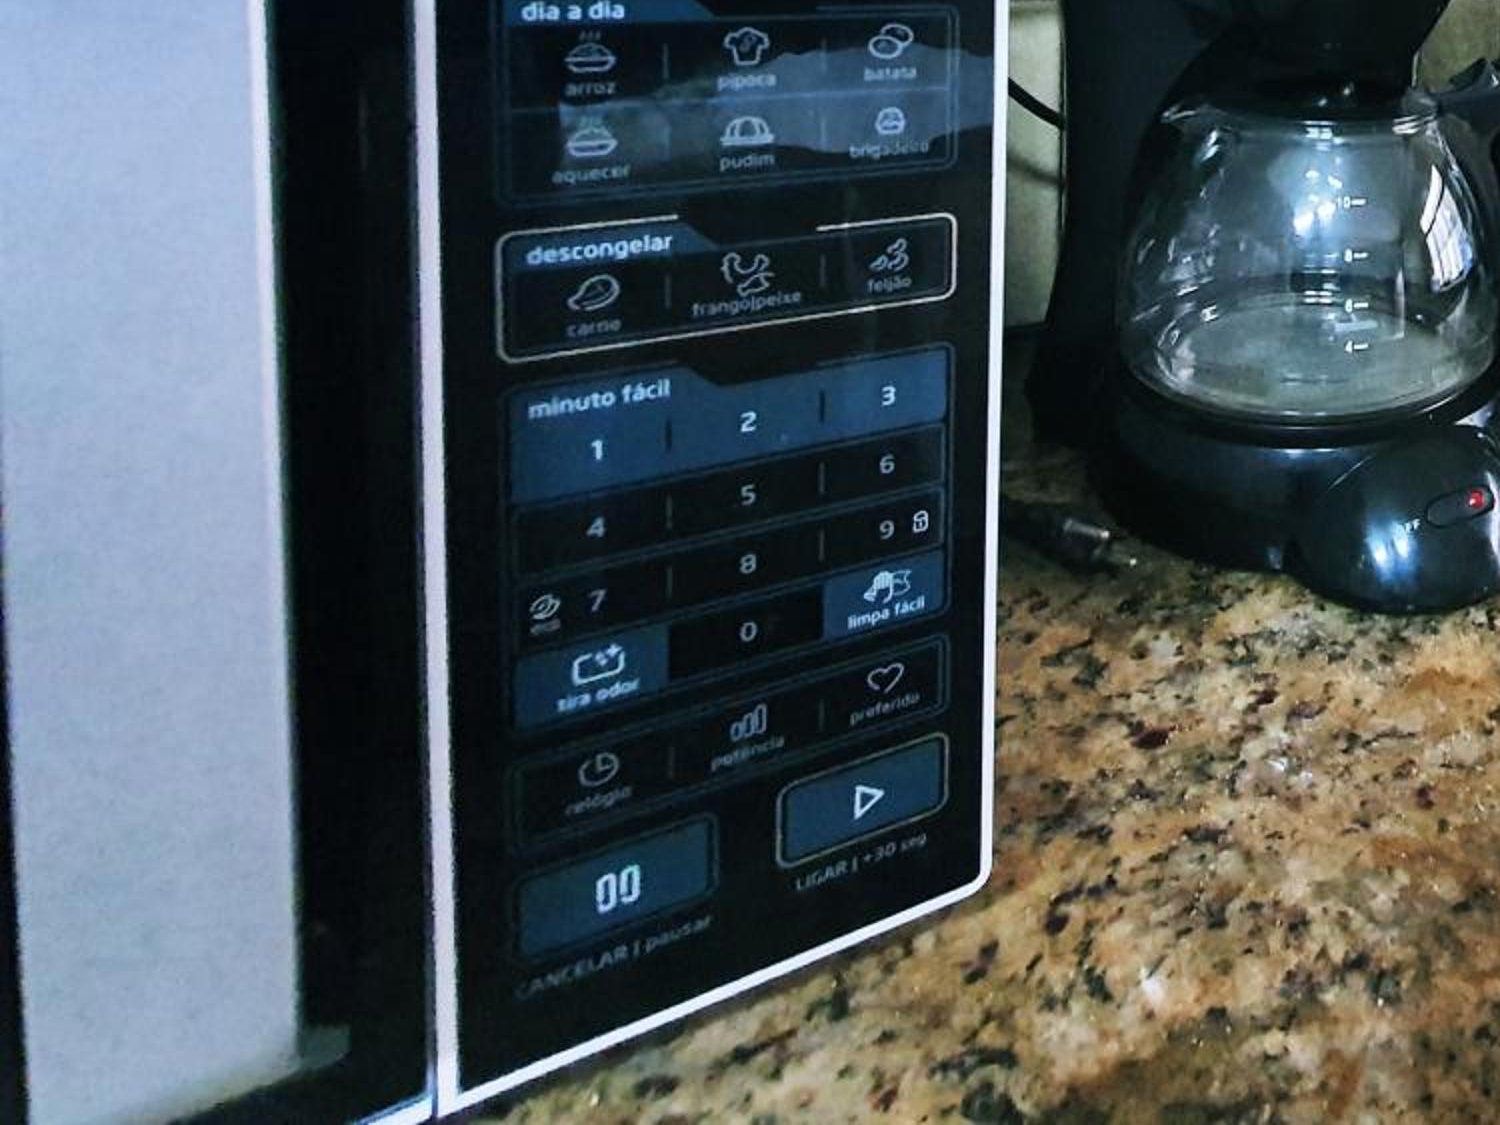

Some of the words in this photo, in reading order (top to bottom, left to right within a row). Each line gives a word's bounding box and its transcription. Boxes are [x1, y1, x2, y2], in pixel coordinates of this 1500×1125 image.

[522, 2, 560, 22] dia
[567, 6, 583, 21] a
[589, 0, 625, 21] dia
[716, 72, 777, 92] pipoca
[864, 65, 917, 82] batata
[565, 80, 616, 97] arroz
[719, 152, 775, 172] pudim
[552, 163, 630, 186] aquecer
[526, 235, 673, 266] descongelar
[867, 275, 913, 295] feijão
[566, 317, 622, 338] carne
[528, 389, 615, 420] minuto
[622, 378, 672, 404] fácil
[880, 385, 898, 406] 3
[739, 411, 758, 433] 2
[591, 439, 604, 461] 1
[879, 454, 896, 475] 6
[740, 485, 757, 506] 5
[585, 516, 606, 538] 4
[878, 520, 896, 541] 9
[739, 554, 758, 574] 8
[587, 590, 606, 612] 7
[847, 605, 891, 631] limpa
[894, 596, 926, 620] fácil
[740, 622, 758, 643] 0
[556, 691, 592, 713] tira
[595, 677, 641, 701] odor
[849, 691, 921, 727] preferido
[564, 785, 634, 817] relógio
[796, 860, 848, 891] LIGAR
[861, 840, 897, 866] +30
[517, 944, 630, 998] CANCELAR
[645, 914, 714, 956] pausar
